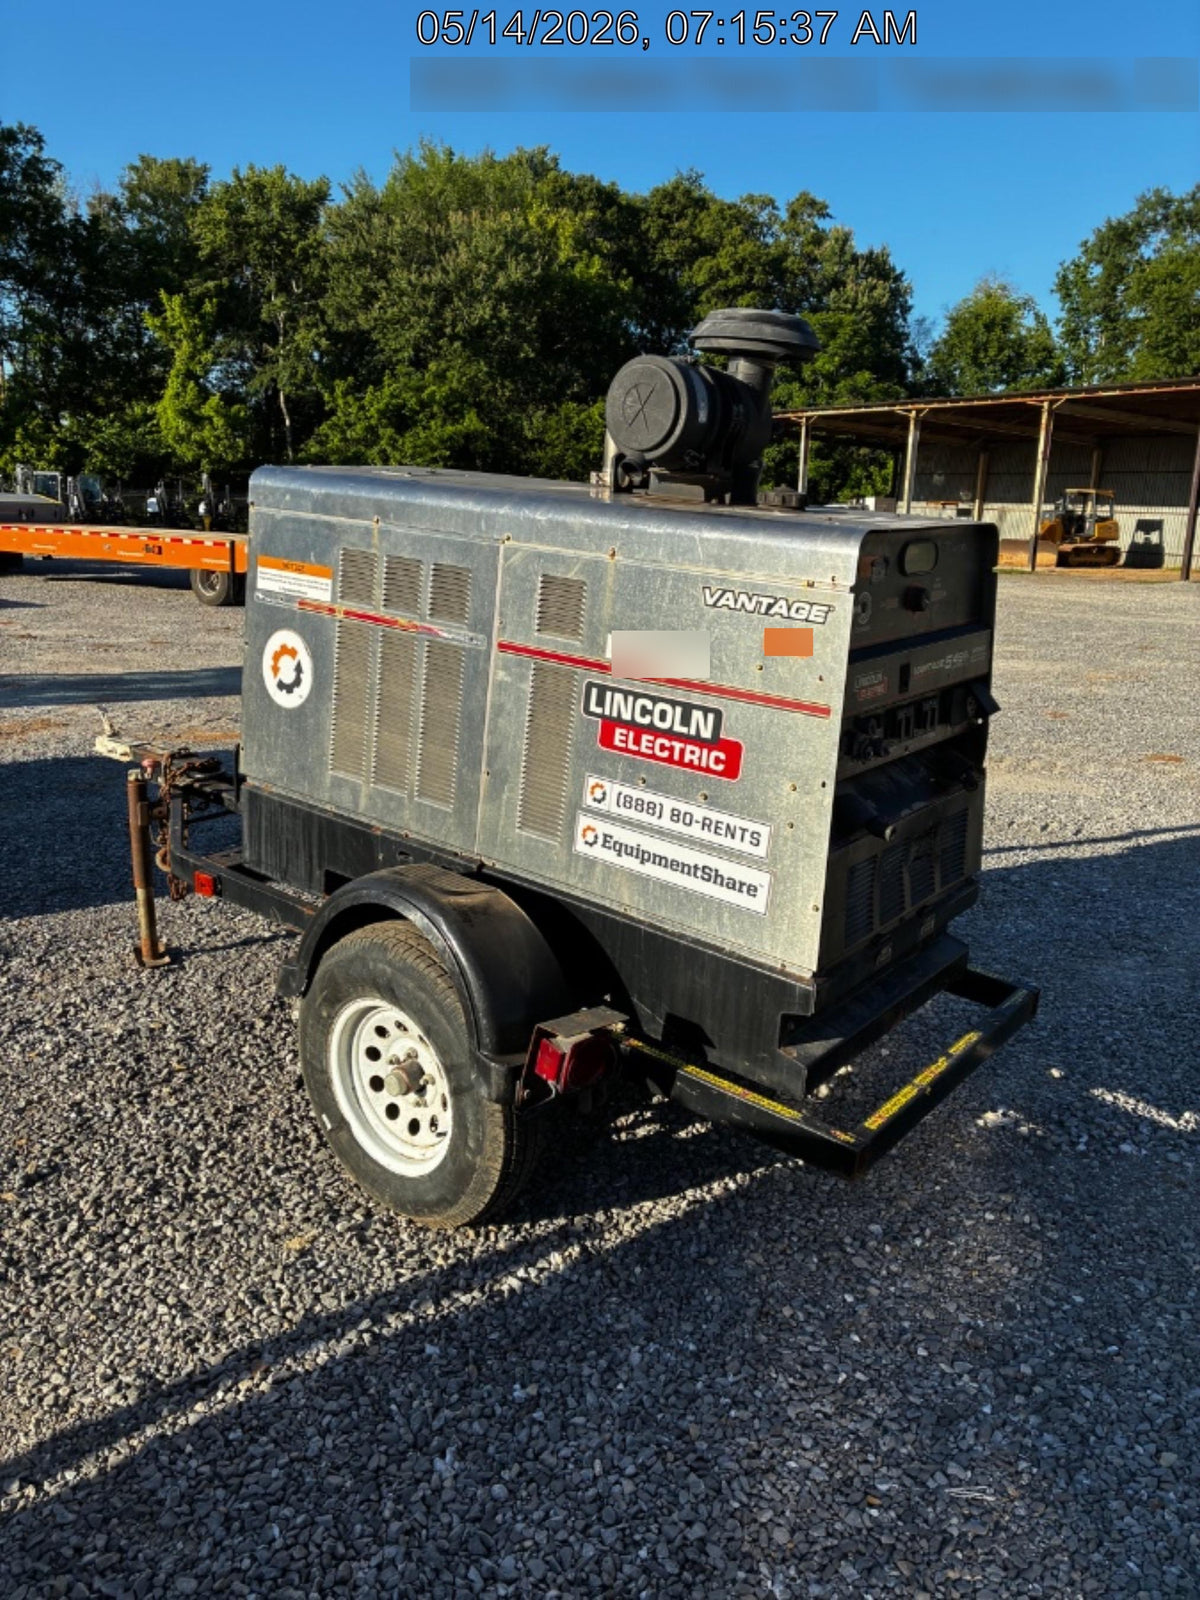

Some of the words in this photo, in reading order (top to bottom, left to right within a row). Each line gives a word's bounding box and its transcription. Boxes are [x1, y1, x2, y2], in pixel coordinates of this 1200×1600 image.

[702, 586, 829, 624] VANTAGE
[589, 687, 714, 739] LINCOLN
[613, 726, 726, 772] ELECTRIC
[616, 791, 664, 819] (888)
[669, 808, 762, 848] 80-RENTS
[601, 833, 759, 898] EquipmentShare
